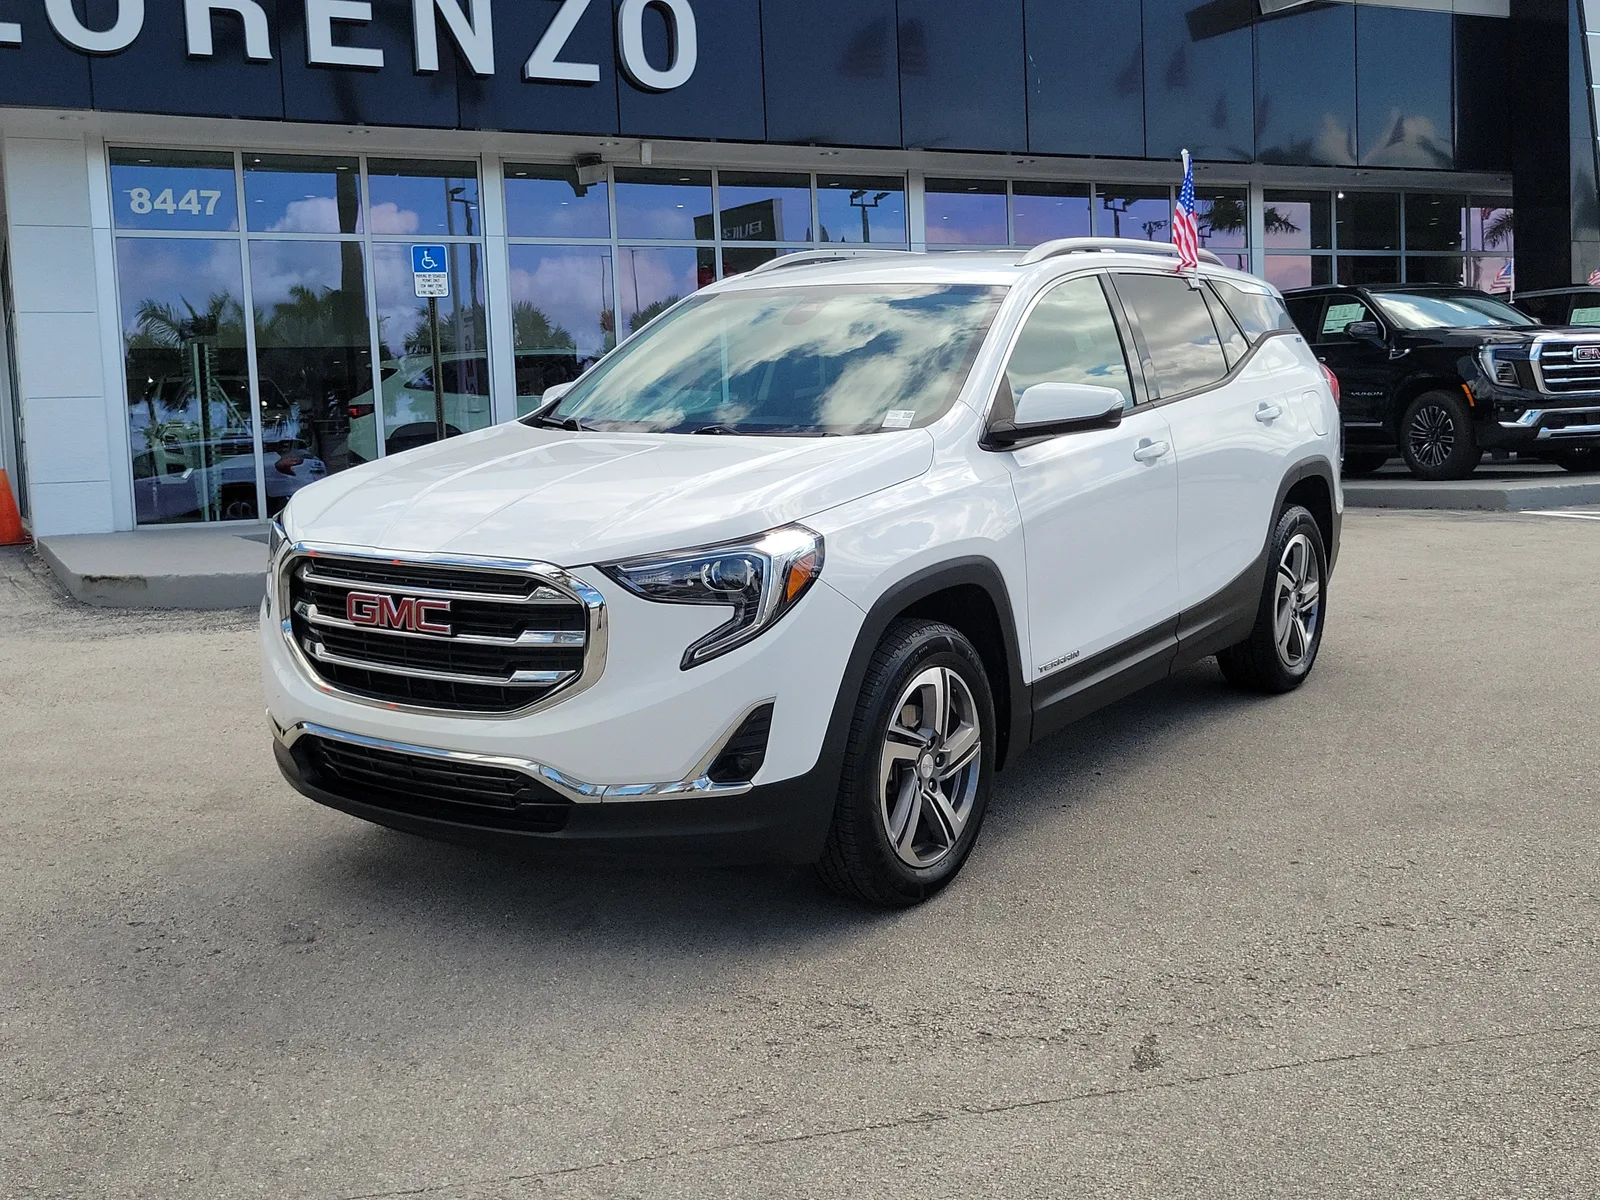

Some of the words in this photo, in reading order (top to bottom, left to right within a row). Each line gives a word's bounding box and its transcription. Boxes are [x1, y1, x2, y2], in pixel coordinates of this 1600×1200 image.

[0, 0, 698, 91] ORENZO
[130, 187, 221, 215] 8447
[347, 591, 452, 635] GMC
[1037, 649, 1080, 673] TERRAIN
